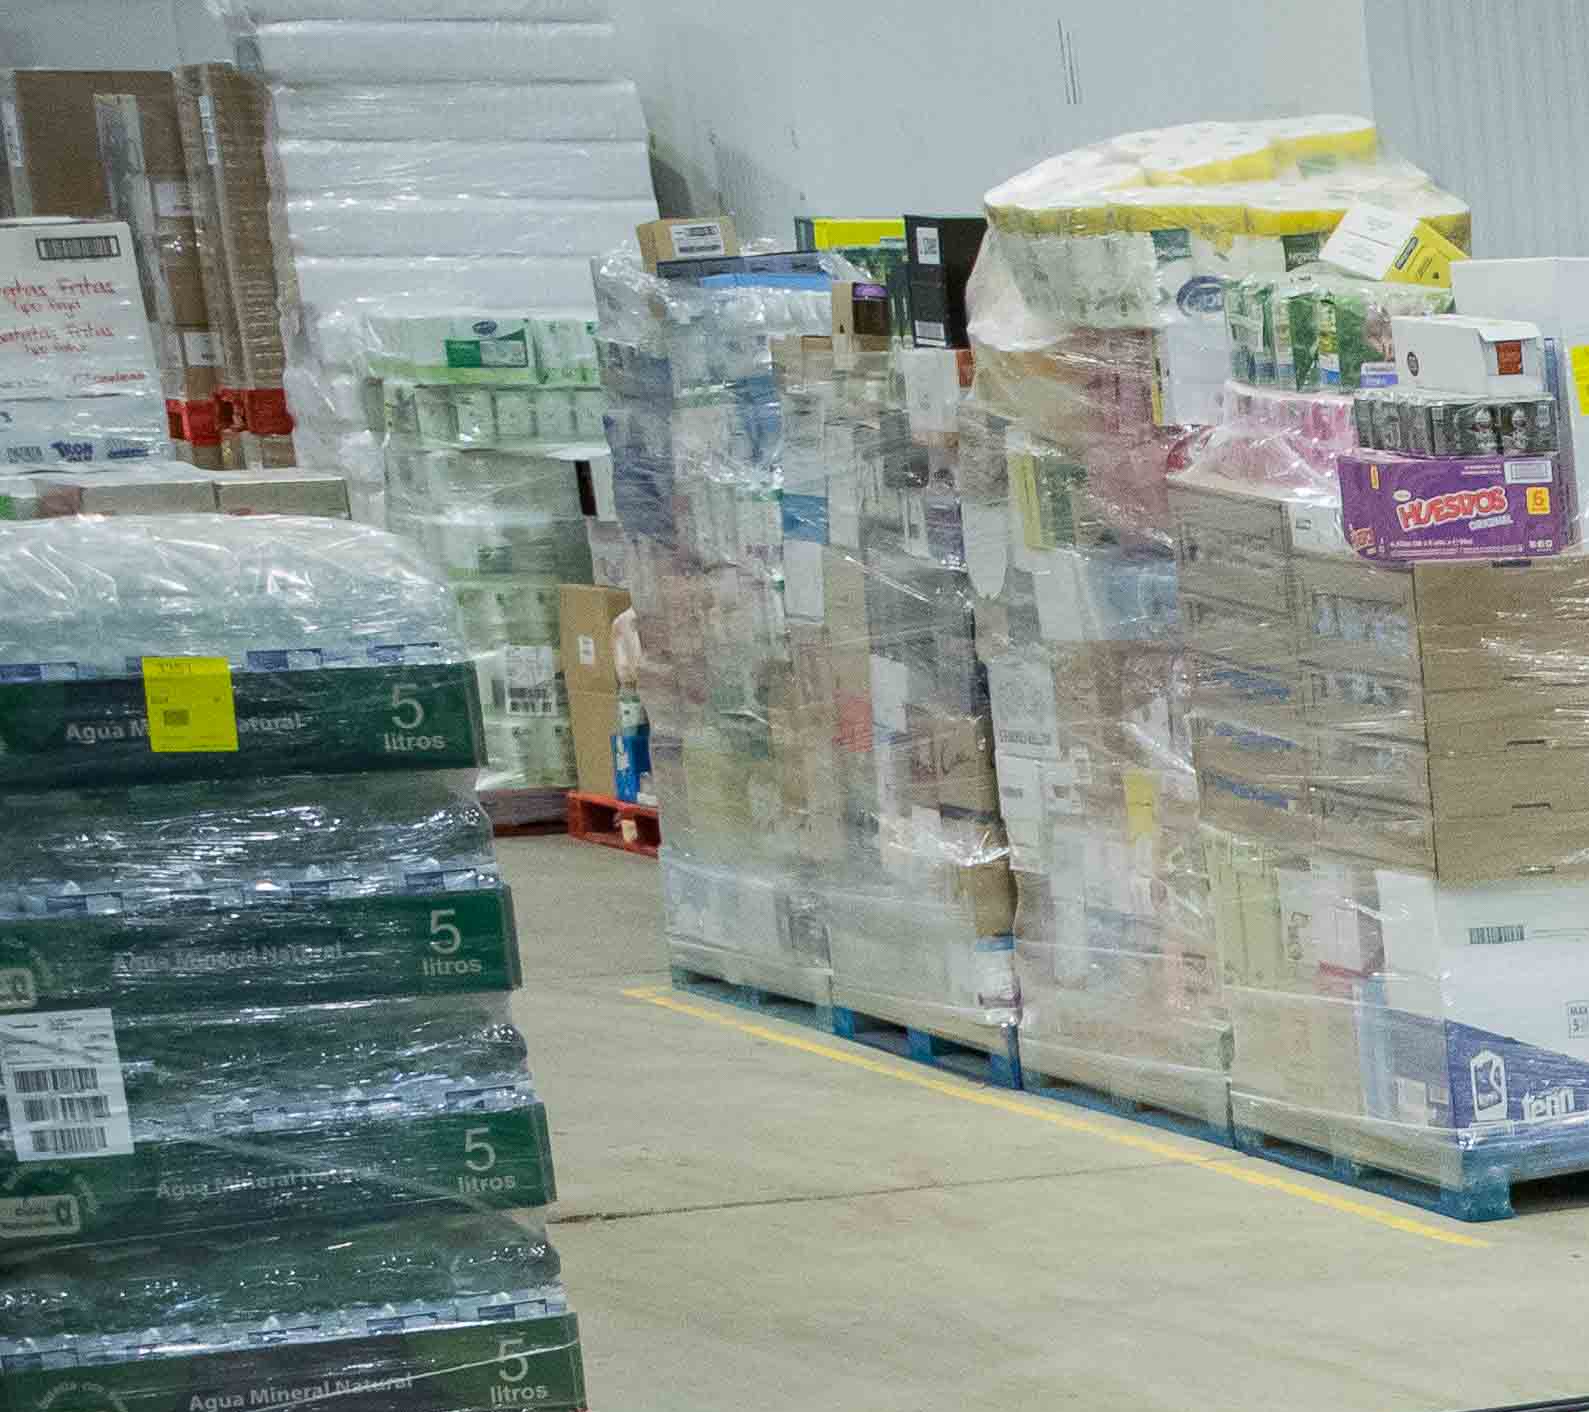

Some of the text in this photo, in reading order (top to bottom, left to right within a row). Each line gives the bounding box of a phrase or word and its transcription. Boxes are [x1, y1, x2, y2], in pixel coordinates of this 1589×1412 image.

[1398, 486, 1507, 531] HUESITOS
[237, 711, 306, 731] atural
[391, 683, 425, 730] 5
[66, 722, 123, 745] Agua
[384, 731, 446, 752] litros
[429, 908, 461, 954] 5
[422, 956, 483, 977] litros
[463, 1127, 497, 1172] 5
[457, 1173, 517, 1193] litros
[498, 1337, 529, 1384] 5
[250, 1379, 333, 1407] Mineral
[337, 1372, 414, 1397] Natural
[489, 1381, 550, 1402] litros
